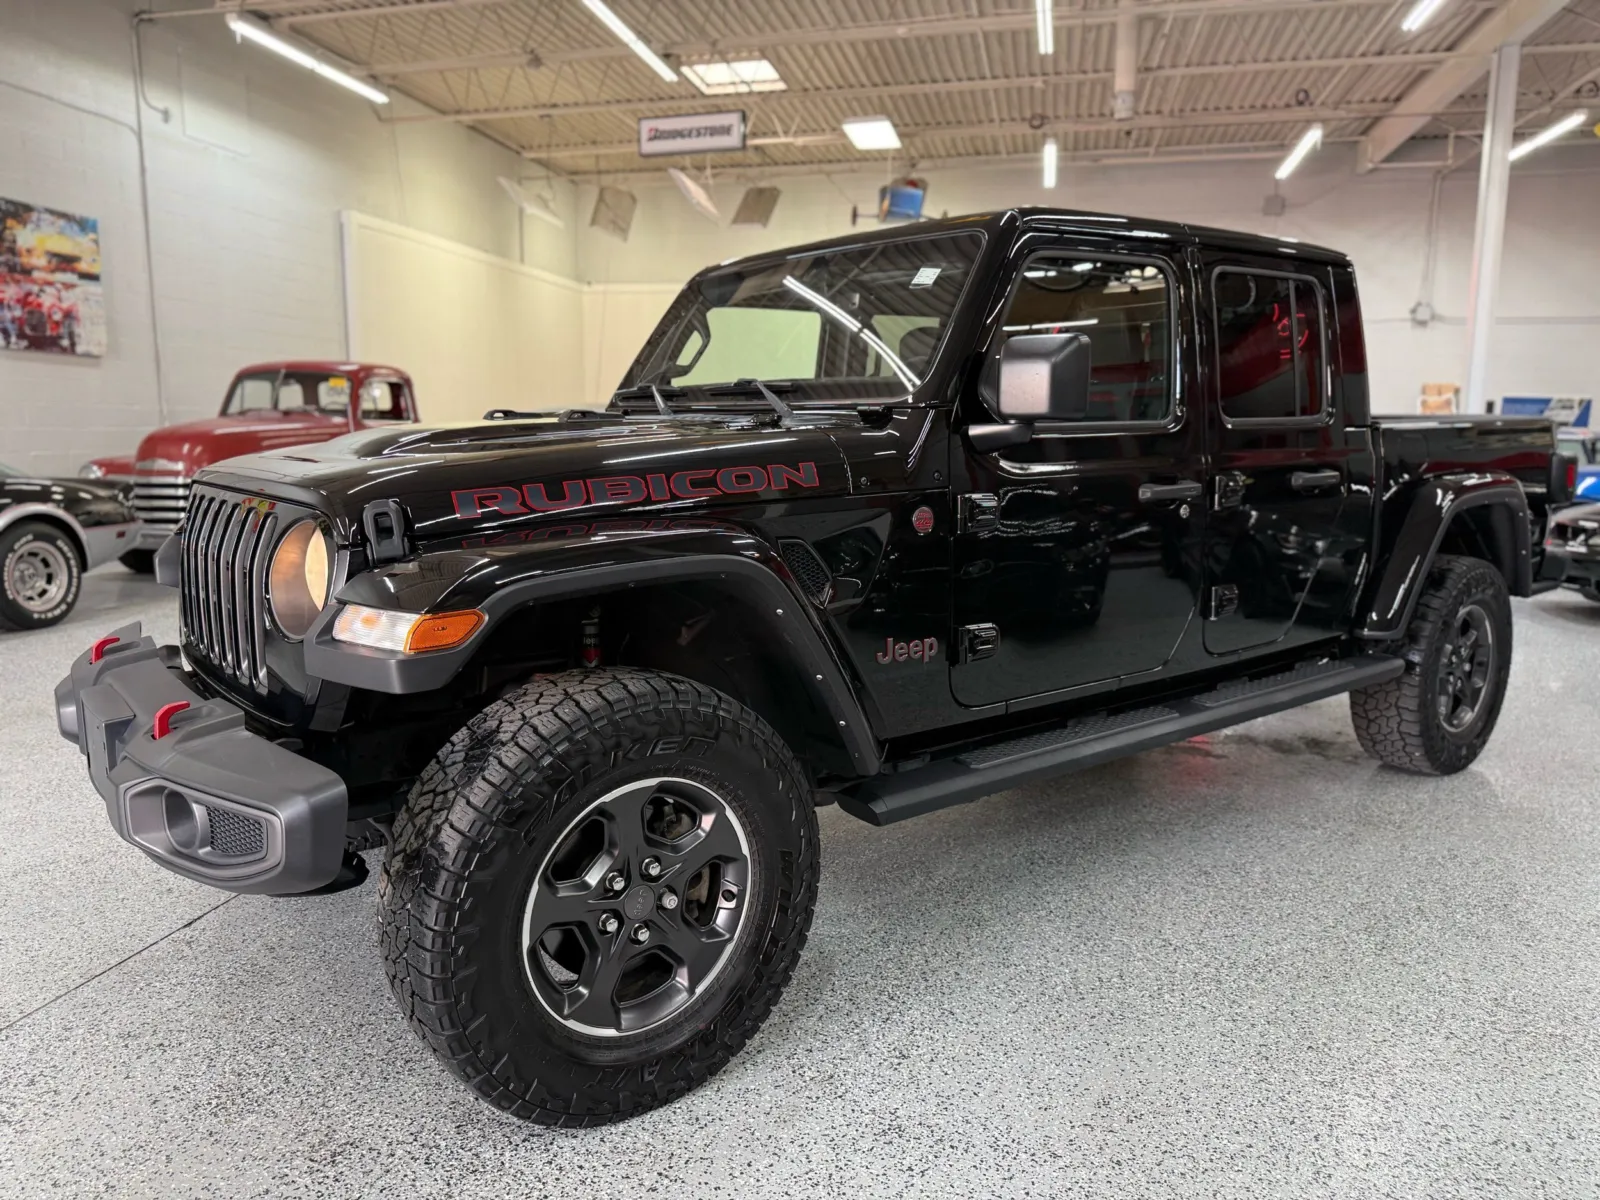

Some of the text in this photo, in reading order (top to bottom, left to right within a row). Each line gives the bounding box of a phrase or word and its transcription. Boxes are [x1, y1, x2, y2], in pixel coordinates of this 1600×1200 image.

[647, 124, 734, 141] BRIDGESTONE
[451, 462, 819, 519] RUBICON
[875, 637, 938, 664] Jeep
